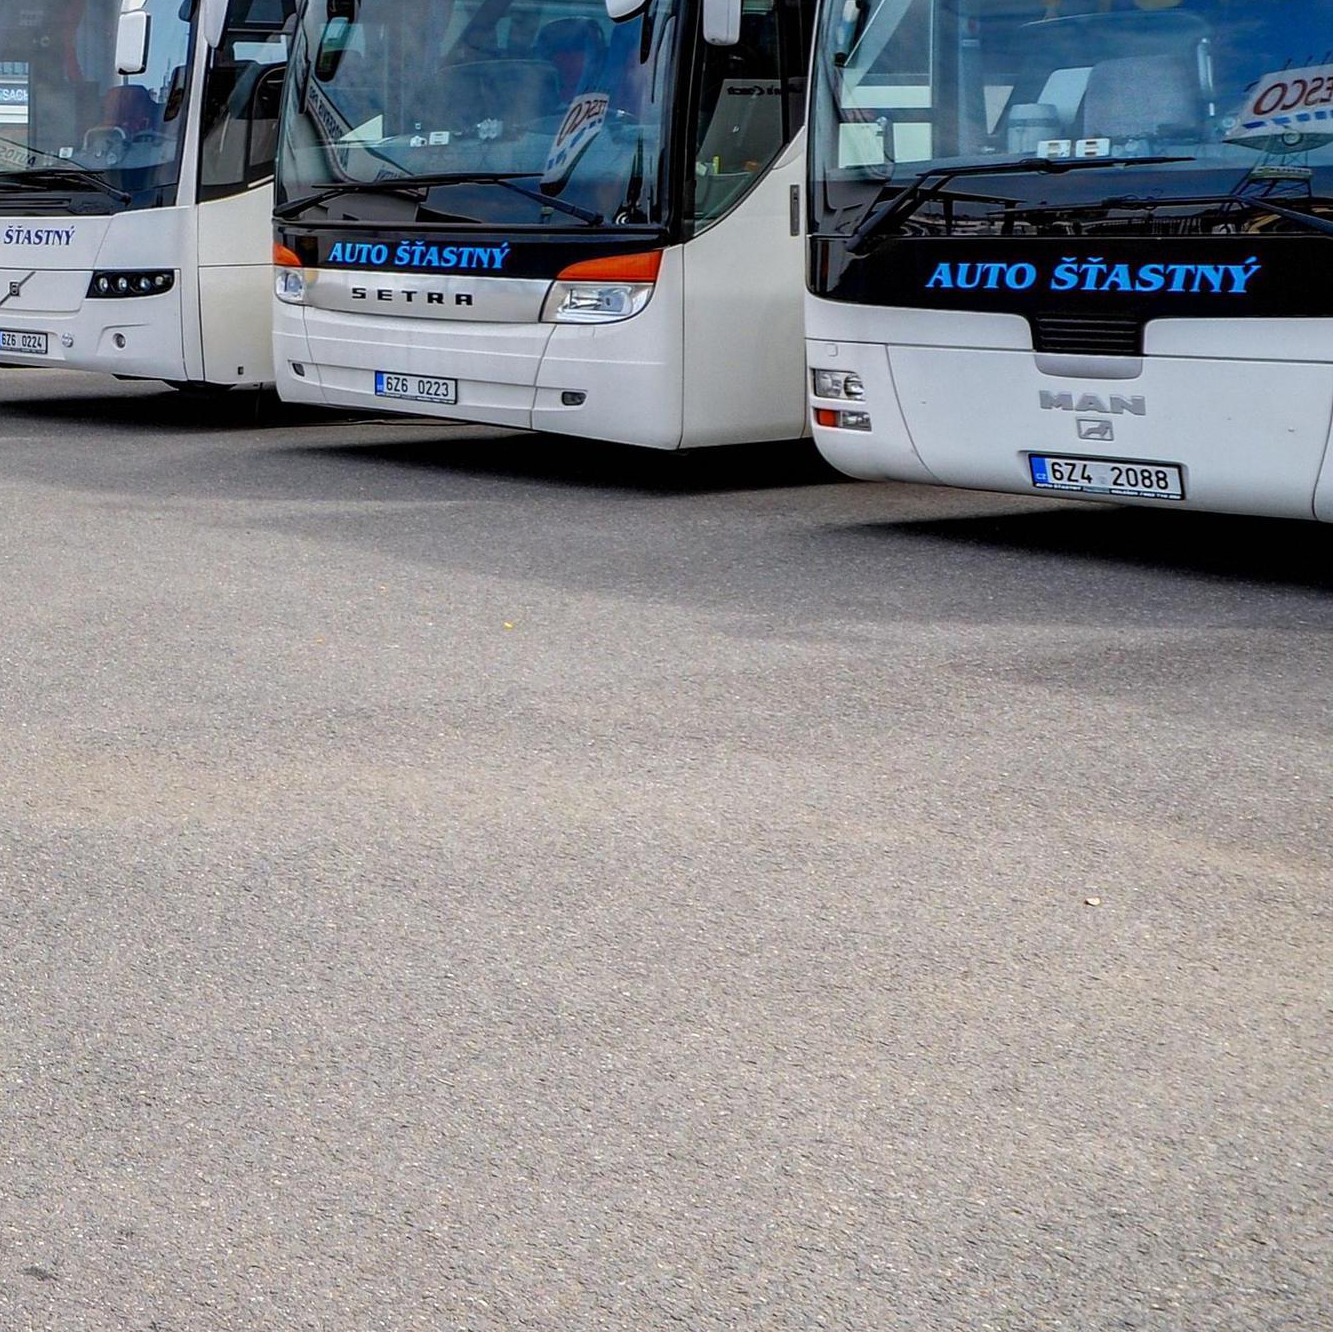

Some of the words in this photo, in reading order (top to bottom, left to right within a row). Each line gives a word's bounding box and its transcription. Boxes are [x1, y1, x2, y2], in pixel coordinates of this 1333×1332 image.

[4, 225, 75, 245] ŠŤASTNÝ
[328, 242, 388, 266] AUTO
[395, 240, 510, 269] ŠŤASTNÝ
[926, 260, 1036, 290] AUTO
[1050, 256, 1261, 294] ŠŤASTNÝ
[351, 287, 474, 306] SETRA
[2, 333, 17, 346] 6Z6
[21, 335, 42, 348] 0224
[386, 376, 408, 393] 6Z6
[417, 380, 449, 397] 0223
[1039, 389, 1146, 416] MAN
[1051, 461, 1093, 484] 6Z4
[1110, 466, 1169, 490] 2088
